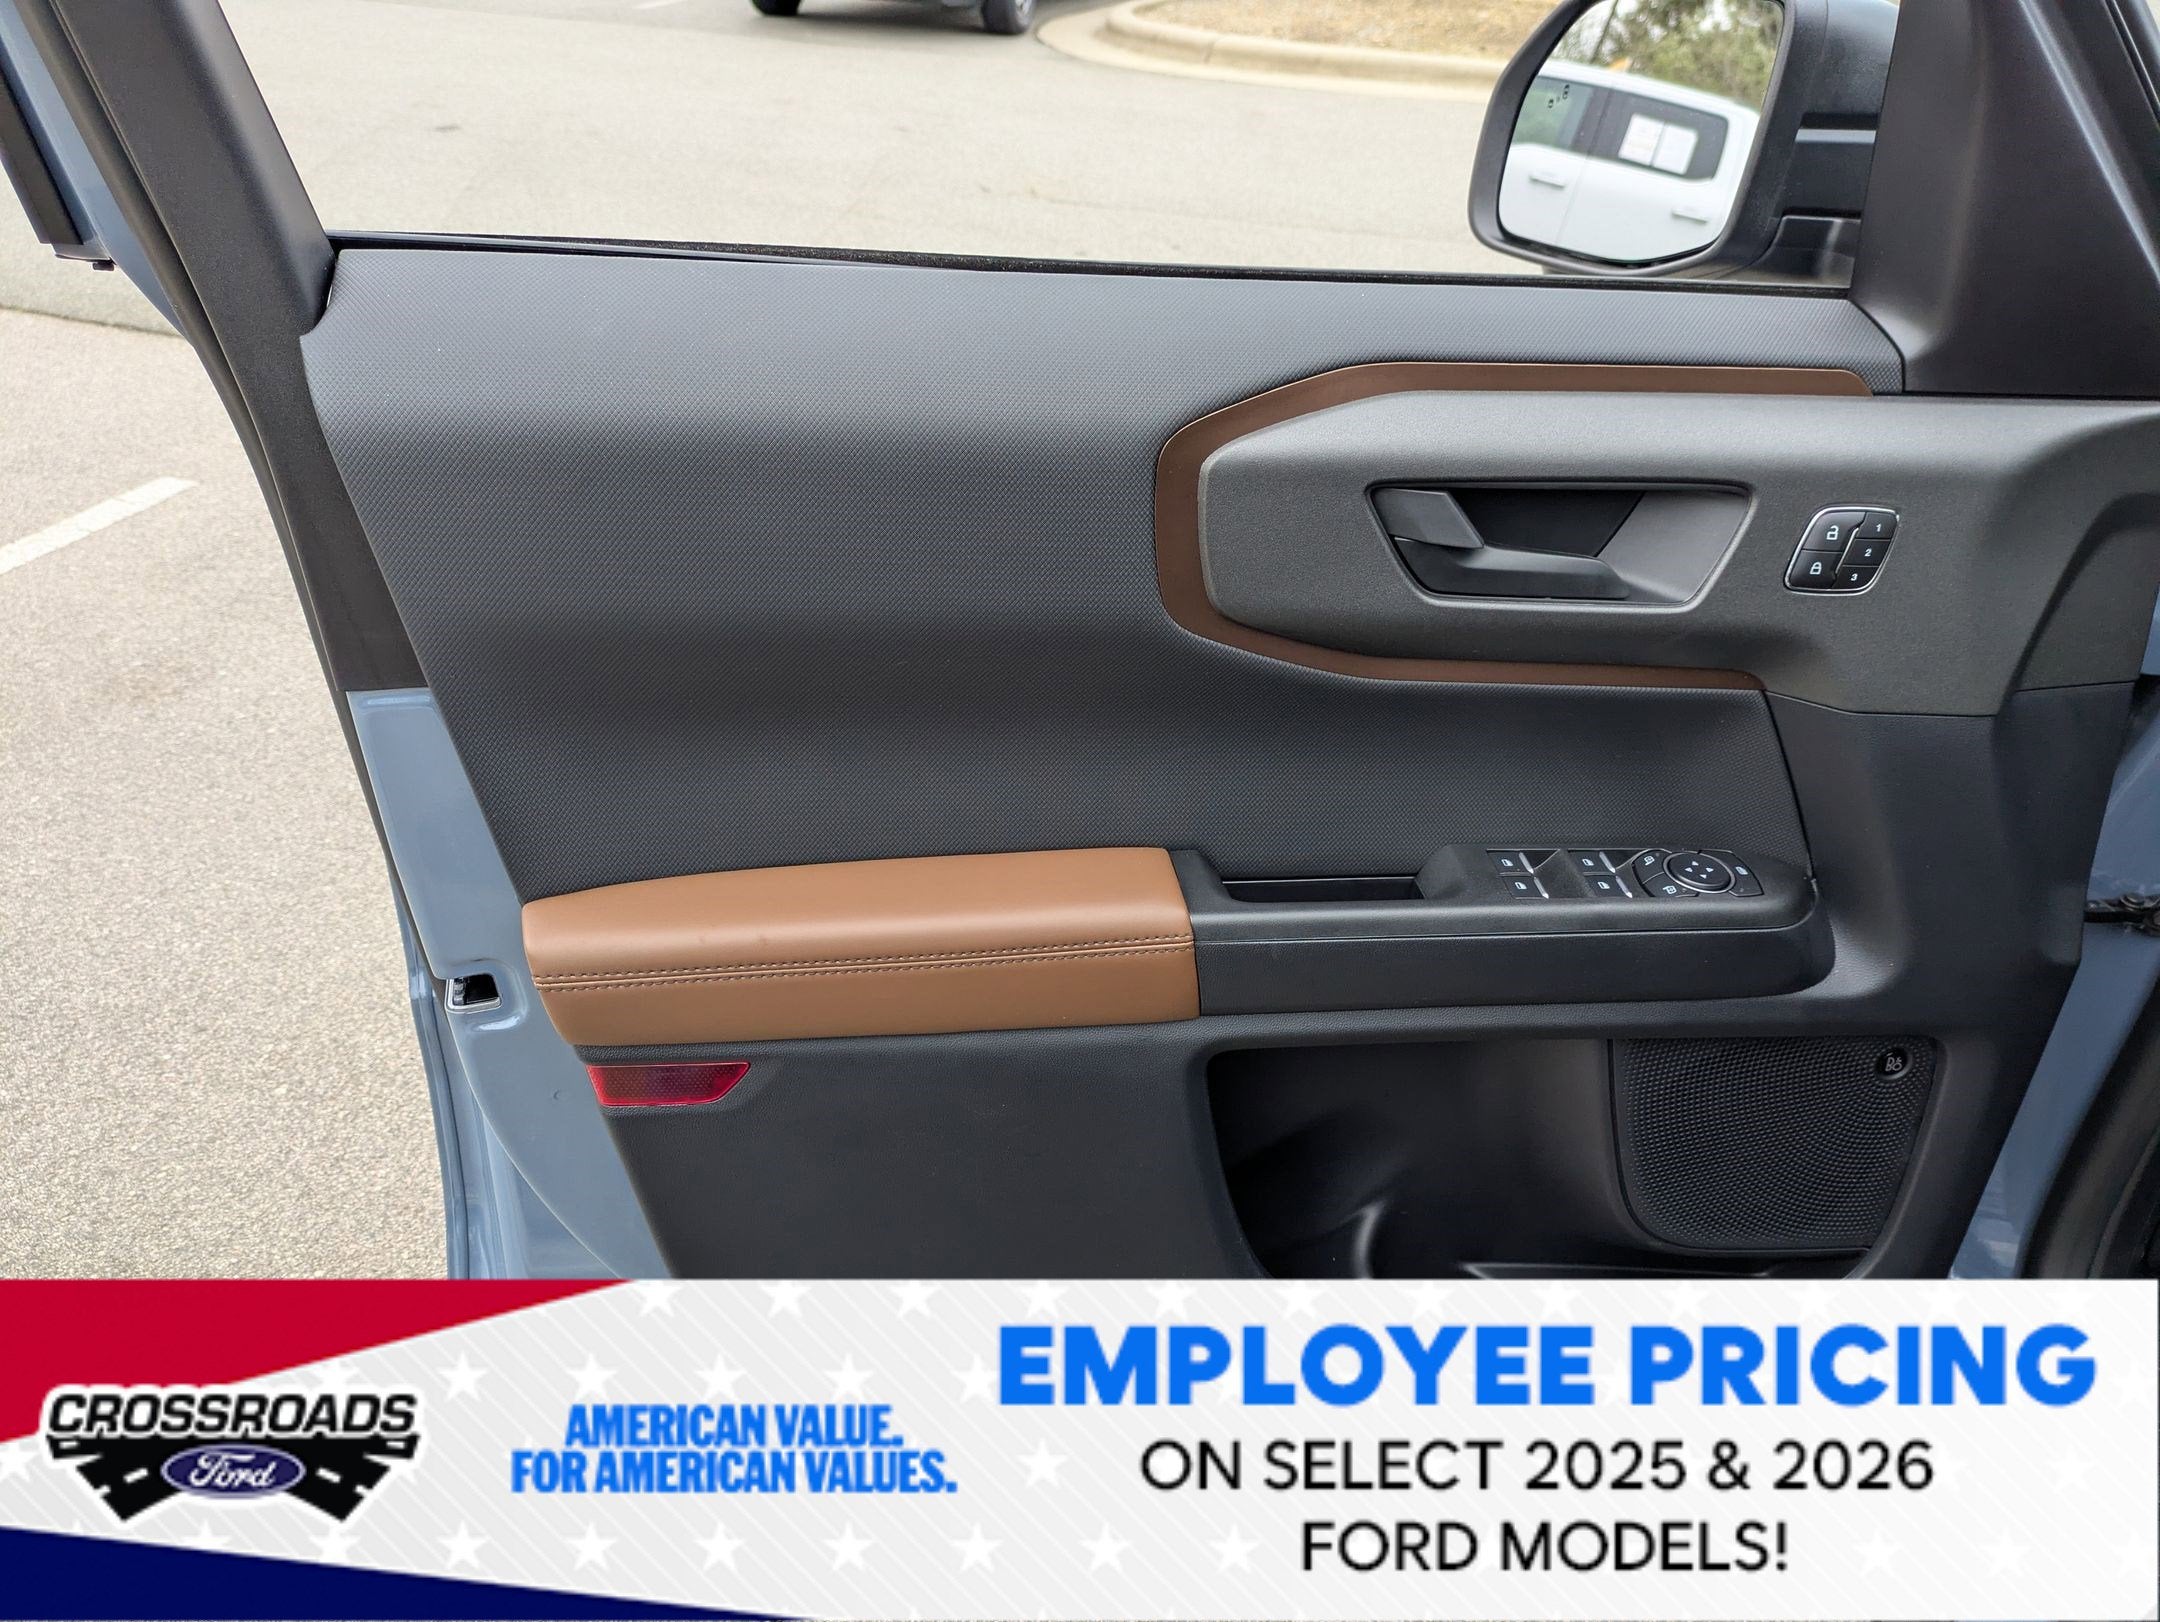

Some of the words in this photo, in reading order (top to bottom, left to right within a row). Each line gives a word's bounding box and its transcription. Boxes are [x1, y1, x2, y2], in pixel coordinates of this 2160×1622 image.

[1876, 523, 1882, 533] 1
[1864, 548, 1872, 557] 2
[1850, 573, 1858, 582] 3
